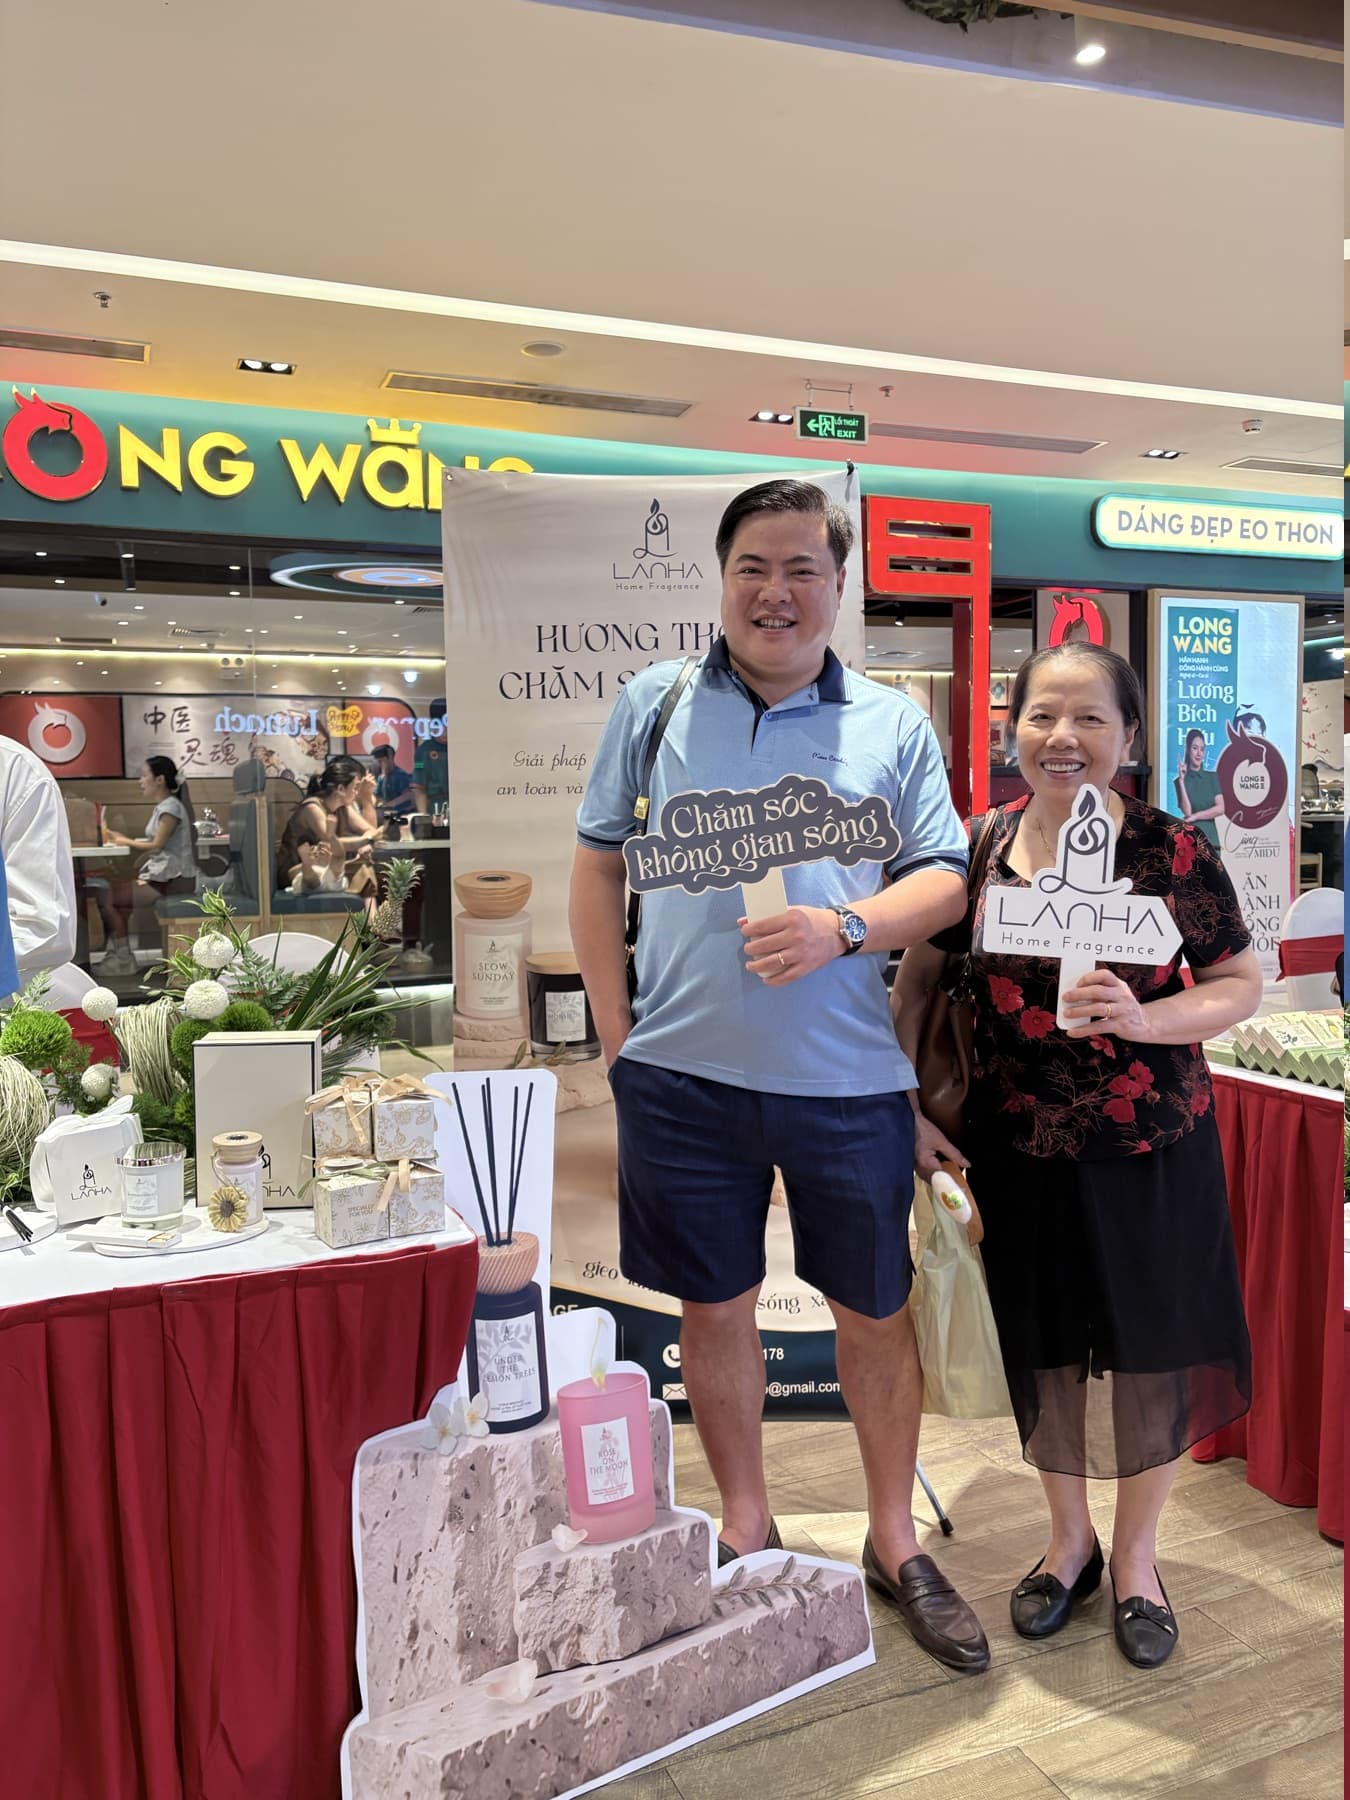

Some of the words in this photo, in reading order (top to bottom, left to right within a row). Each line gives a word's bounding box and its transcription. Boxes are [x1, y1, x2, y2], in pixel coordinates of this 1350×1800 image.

[836, 430, 857, 438] EXIT
[1118, 505, 1184, 534] DÁNG
[1191, 515, 1233, 543] ĐẸP
[1239, 518, 1268, 540] EO
[1275, 521, 1333, 544] THON
[613, 562, 703, 579] LANHA
[616, 582, 644, 590] Home
[649, 582, 699, 591] Fragrance
[536, 622, 659, 652] HƯƠNG
[1178, 616, 1232, 636] LONG
[1173, 635, 1232, 655] WANG
[499, 665, 604, 699] CHĂM
[1178, 680, 1234, 704] Lương
[1178, 703, 1217, 722] Bích
[513, 750, 545, 767] Giải
[550, 744, 587, 771] pháp
[496, 785, 517, 795] an
[566, 783, 584, 794] và
[671, 802, 756, 839] Chăm
[763, 787, 820, 822] sóc
[634, 839, 731, 882] không
[731, 830, 795, 872] gian
[803, 808, 887, 854] sống
[999, 897, 1164, 936] LANHA
[1002, 932, 1051, 948] Home
[1062, 936, 1156, 955] Fragrance
[472, 971, 515, 981] SUNDAY
[582, 1261, 618, 1280] gieo
[757, 1292, 800, 1314] sóng
